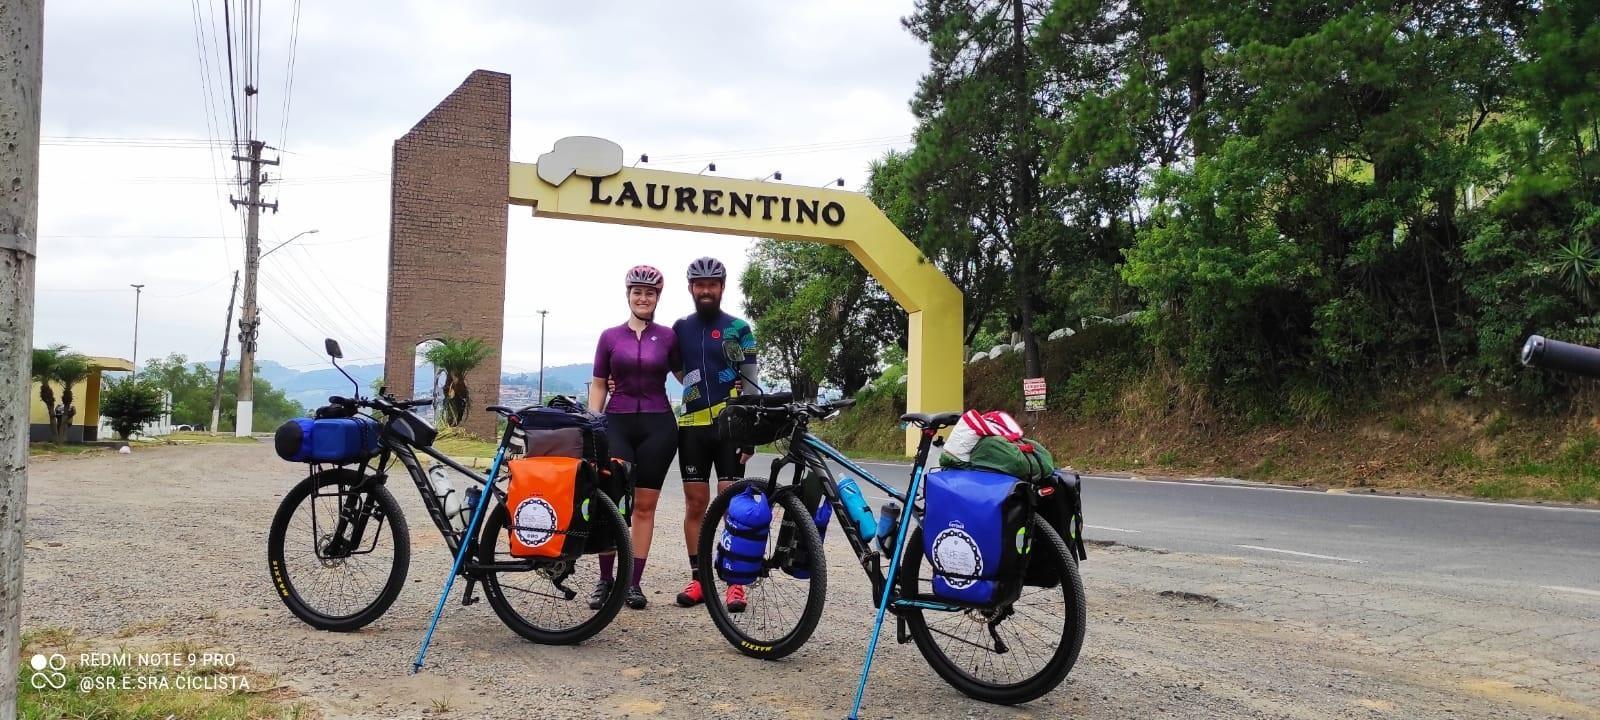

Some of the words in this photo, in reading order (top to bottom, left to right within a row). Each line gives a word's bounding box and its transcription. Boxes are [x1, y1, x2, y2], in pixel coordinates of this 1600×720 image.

[589, 176, 846, 226] LAURENTINO
[272, 560, 289, 597] MAXXIS
[741, 640, 773, 652] MAXXIS
